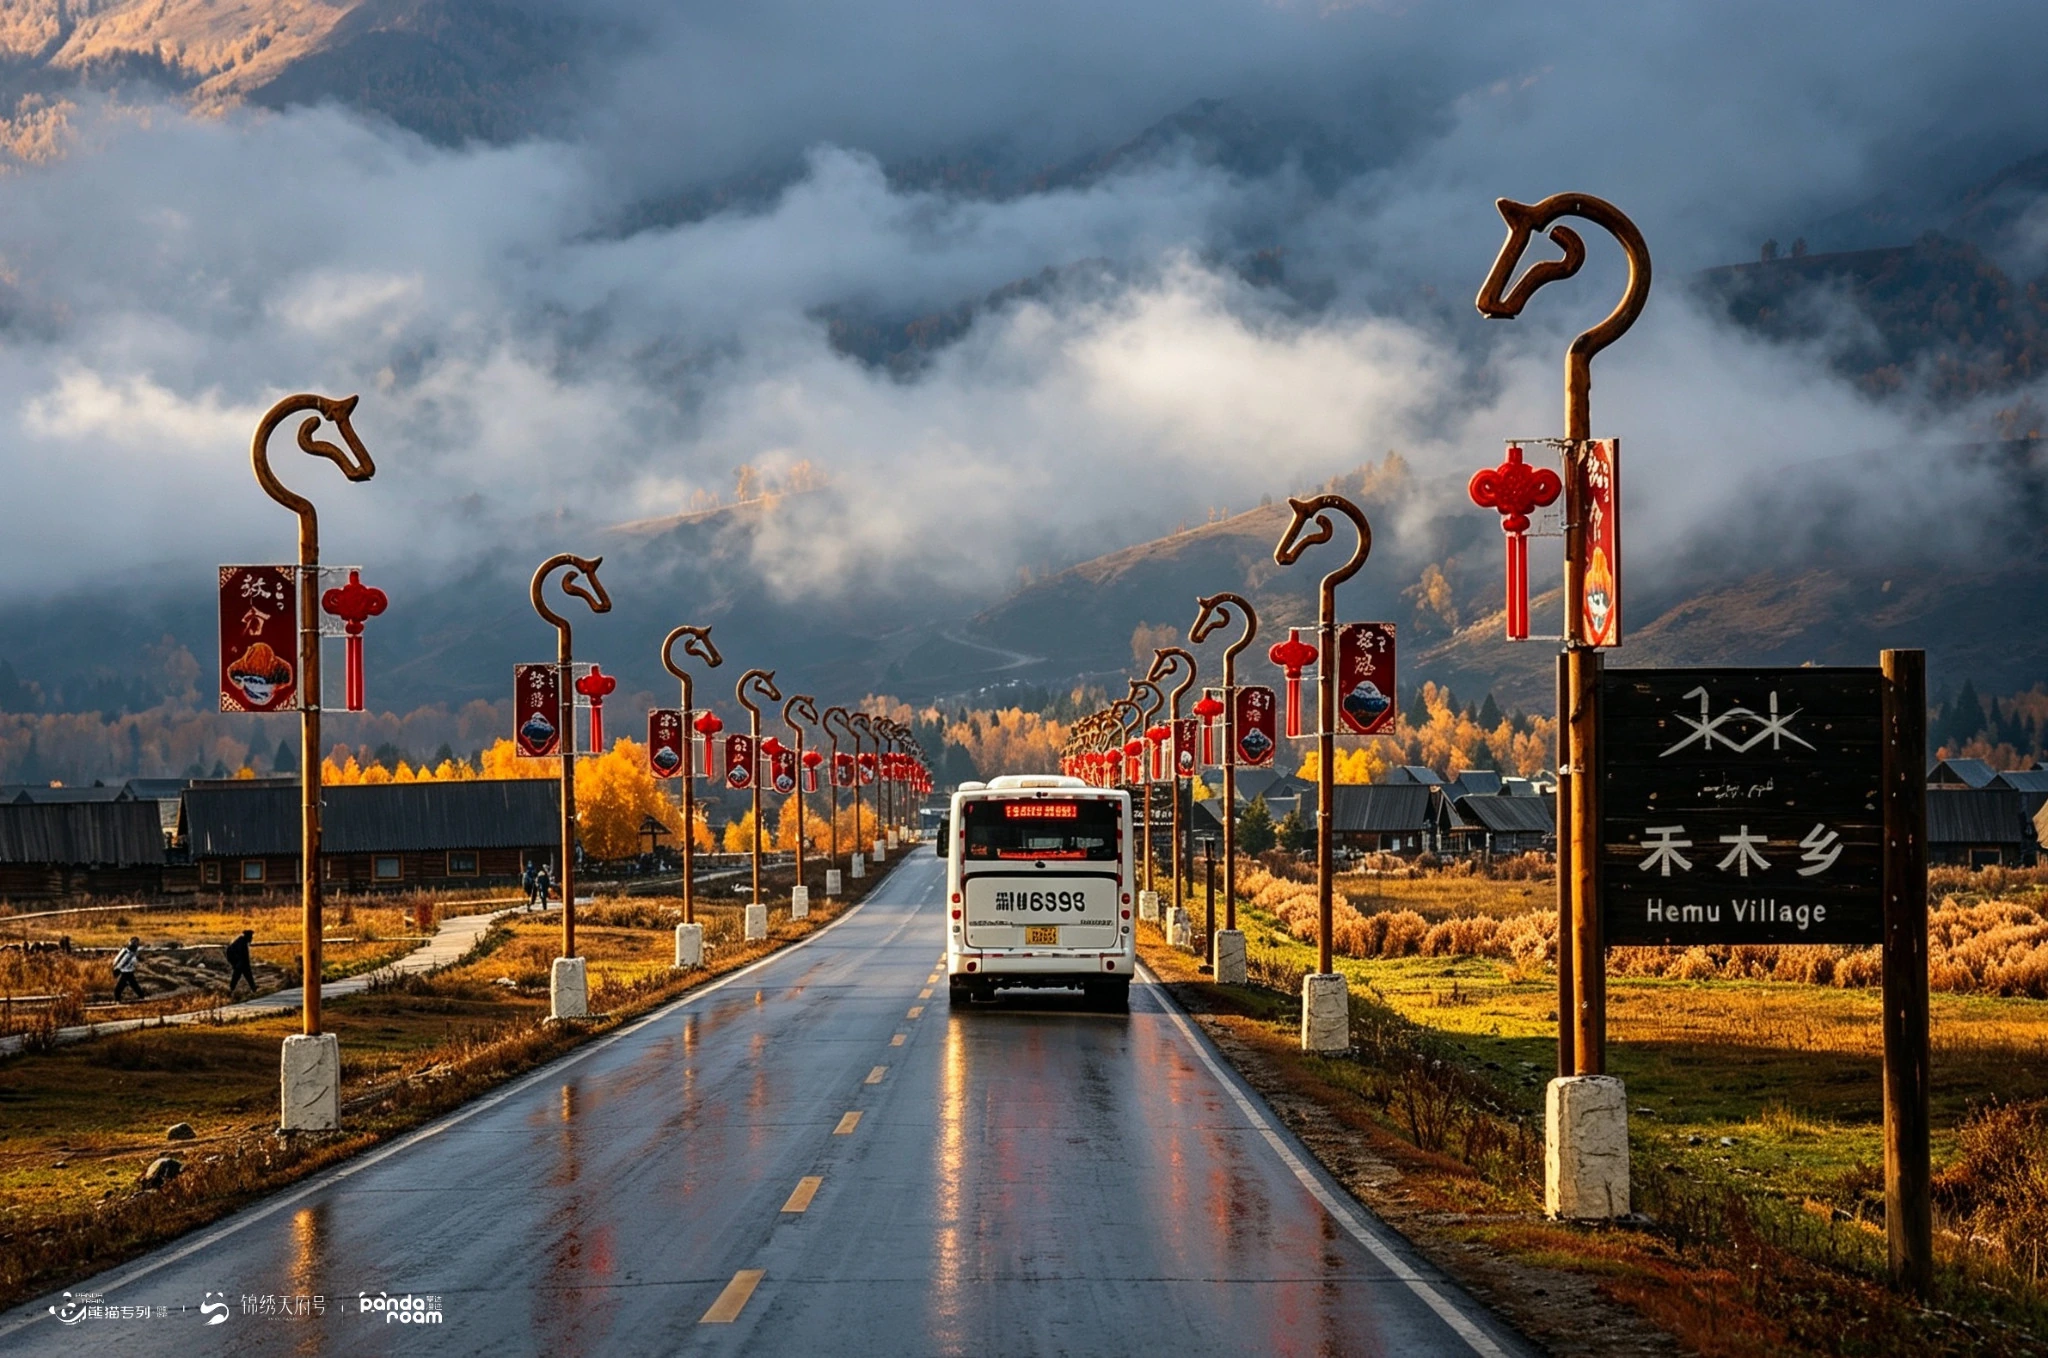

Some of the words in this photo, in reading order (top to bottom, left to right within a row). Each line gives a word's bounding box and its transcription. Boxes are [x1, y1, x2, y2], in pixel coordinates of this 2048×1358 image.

[1638, 823, 1844, 877] 禾木乡
[1647, 898, 1720, 922] Hemu
[1731, 898, 1826, 930] Village
